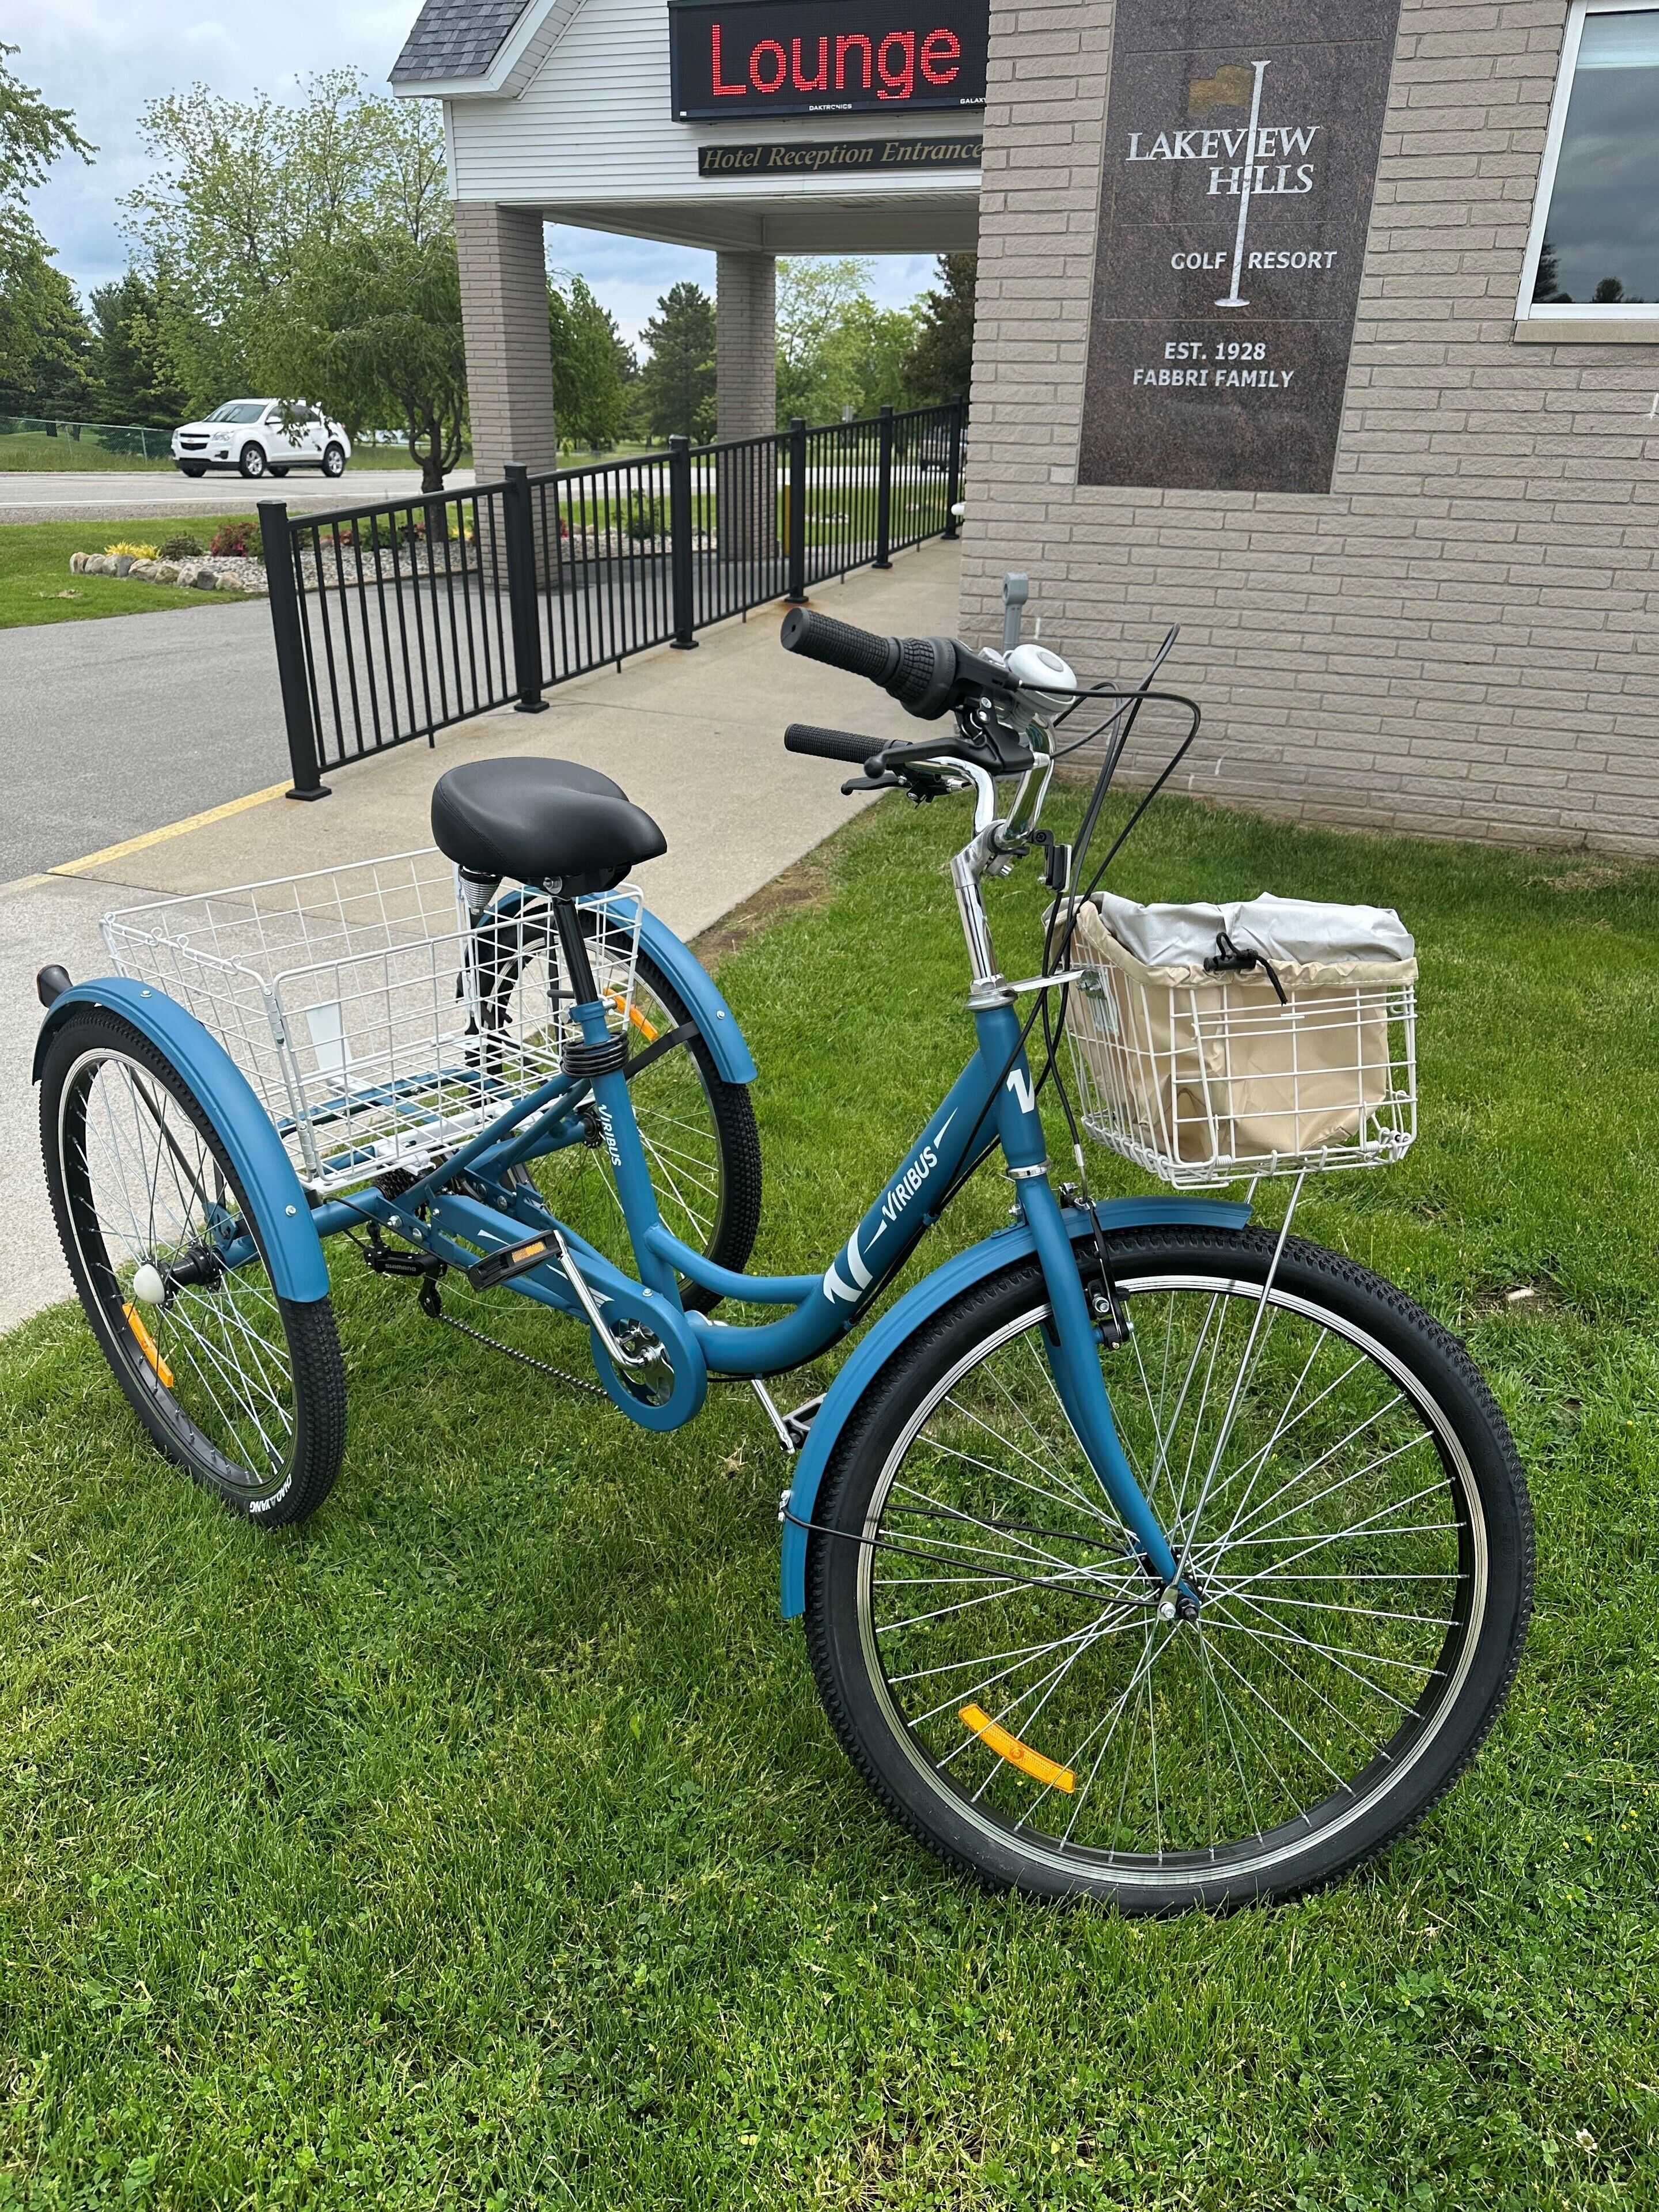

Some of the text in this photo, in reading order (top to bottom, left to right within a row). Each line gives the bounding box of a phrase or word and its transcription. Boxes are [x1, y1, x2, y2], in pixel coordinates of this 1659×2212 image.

[711, 24, 961, 100] Lounge
[702, 142, 983, 171] Hotel Reception Entrance
[1125, 126, 1321, 161] LAKEVIEW
[1206, 164, 1314, 195] HILLS
[1171, 251, 1338, 270] GOLF RESORT
[1164, 342, 1267, 361] EST. 1928
[1132, 369, 1295, 388] FABBRI FAMILY
[598, 1104, 622, 1166] VIRIBUS
[881, 1146, 938, 1221] VIRIBUS
